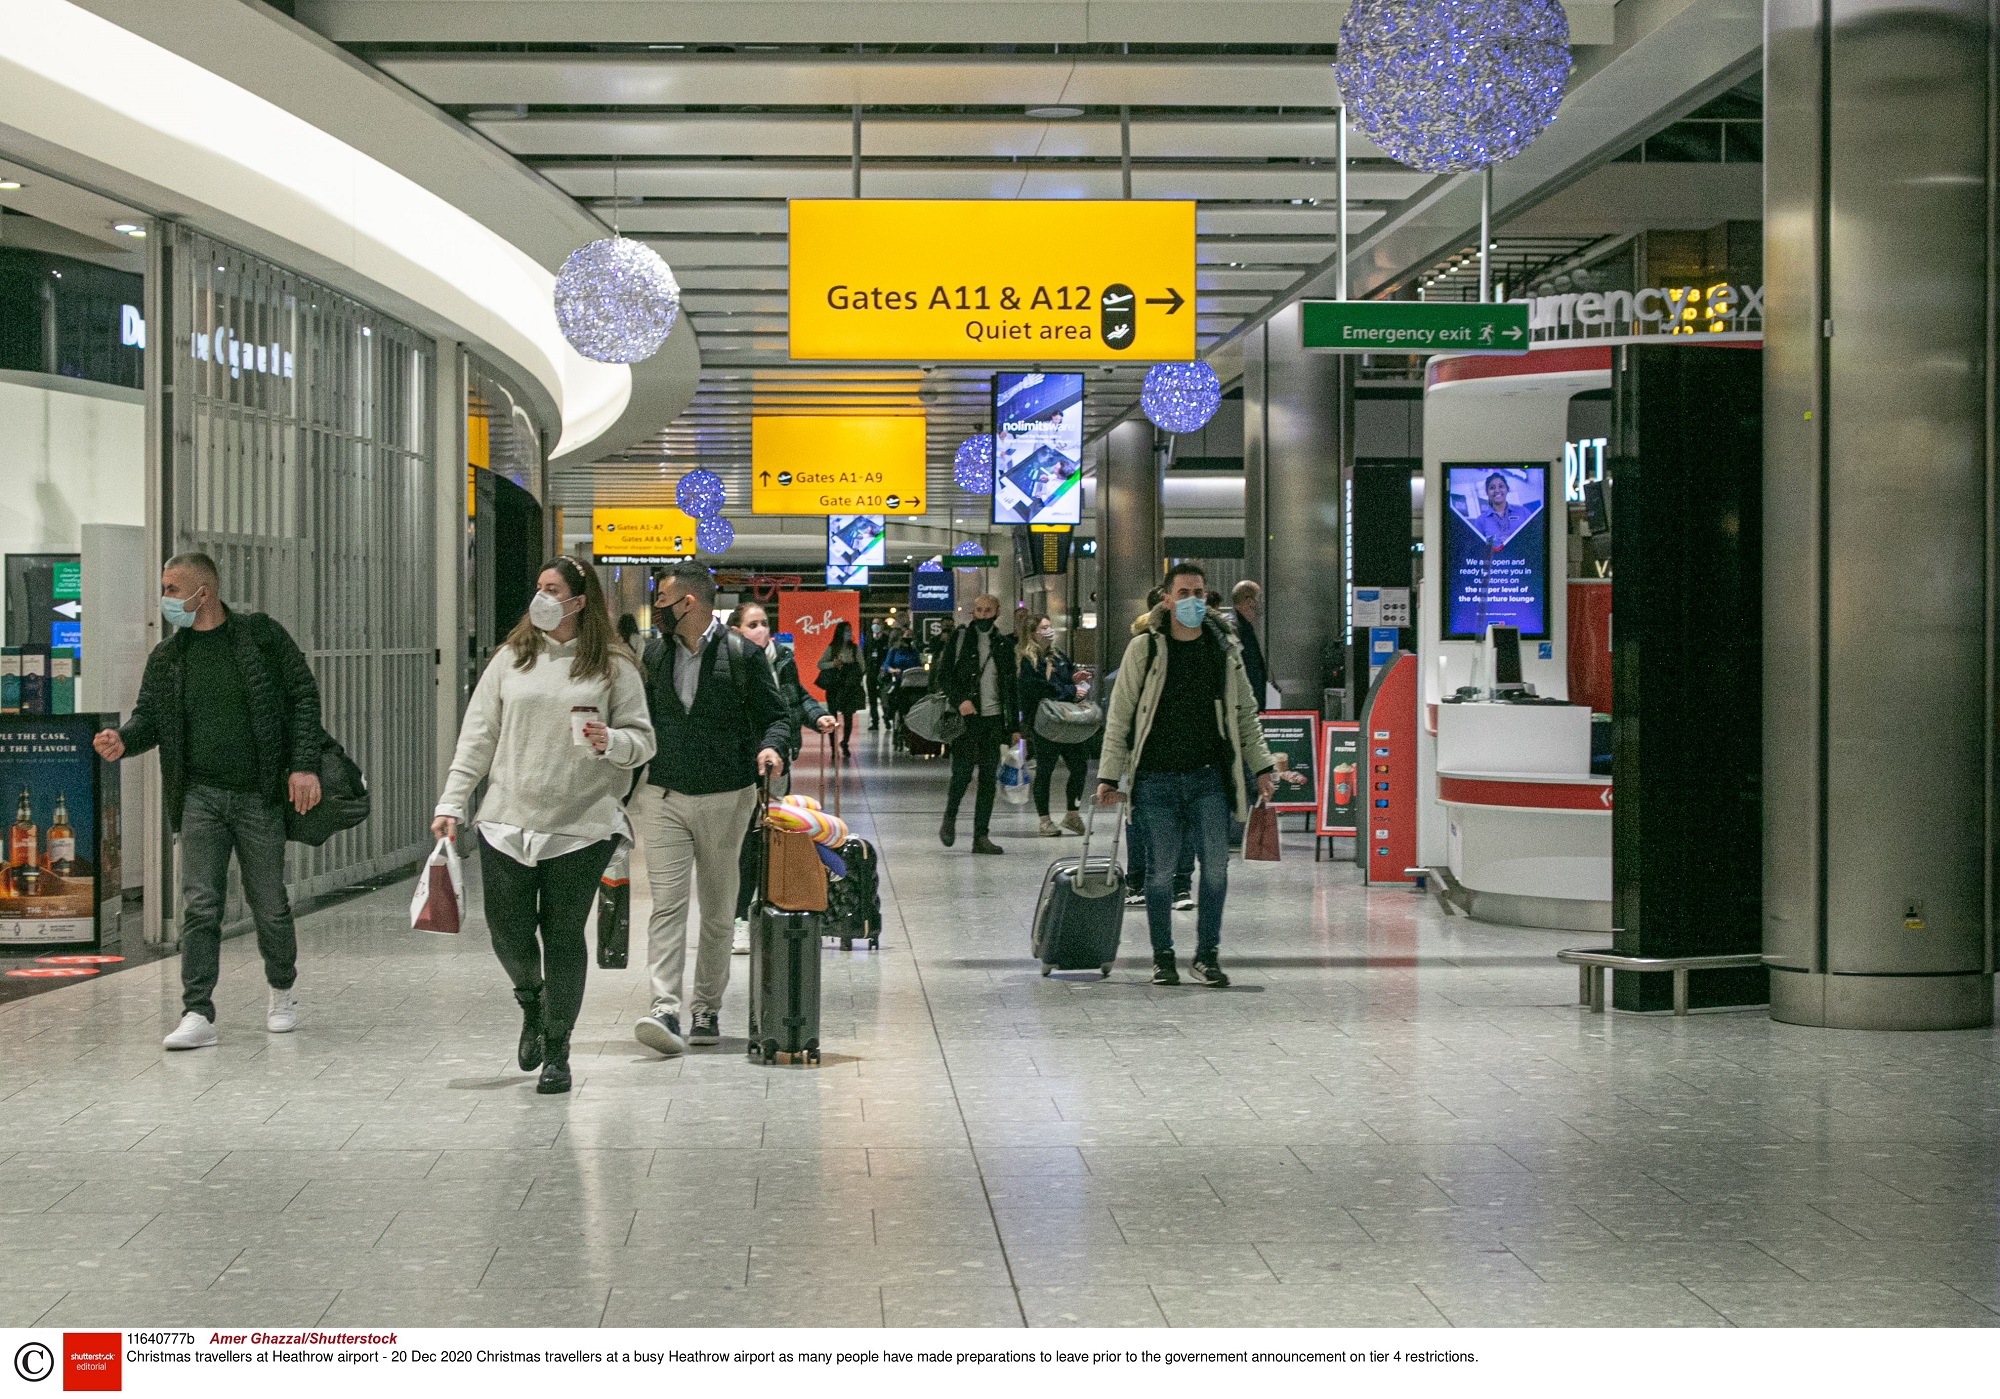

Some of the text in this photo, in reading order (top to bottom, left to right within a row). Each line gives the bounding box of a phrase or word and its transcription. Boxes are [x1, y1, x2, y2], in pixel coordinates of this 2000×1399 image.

[827, 285, 1091, 310] Gates A11 & A12
[965, 320, 1091, 342] Quiet area
[1342, 325, 1471, 343] Emergency exit
[796, 472, 883, 483] Gates A1-A9
[819, 495, 882, 506] Gate A10
[1465, 558, 1478, 566] We
[1491, 559, 1510, 567] open
[1511, 558, 1525, 566] and
[1459, 568, 1480, 576] ready
[1510, 569, 1523, 577] you
[917, 584, 949, 592] Currency
[917, 592, 949, 600] Exchange
[1509, 595, 1535, 604] lounge
[17, 732, 37, 740] THE
[41, 732, 70, 741] CASK,
[10, 745, 29, 753] THE
[33, 744, 77, 753] FLAVOUR
